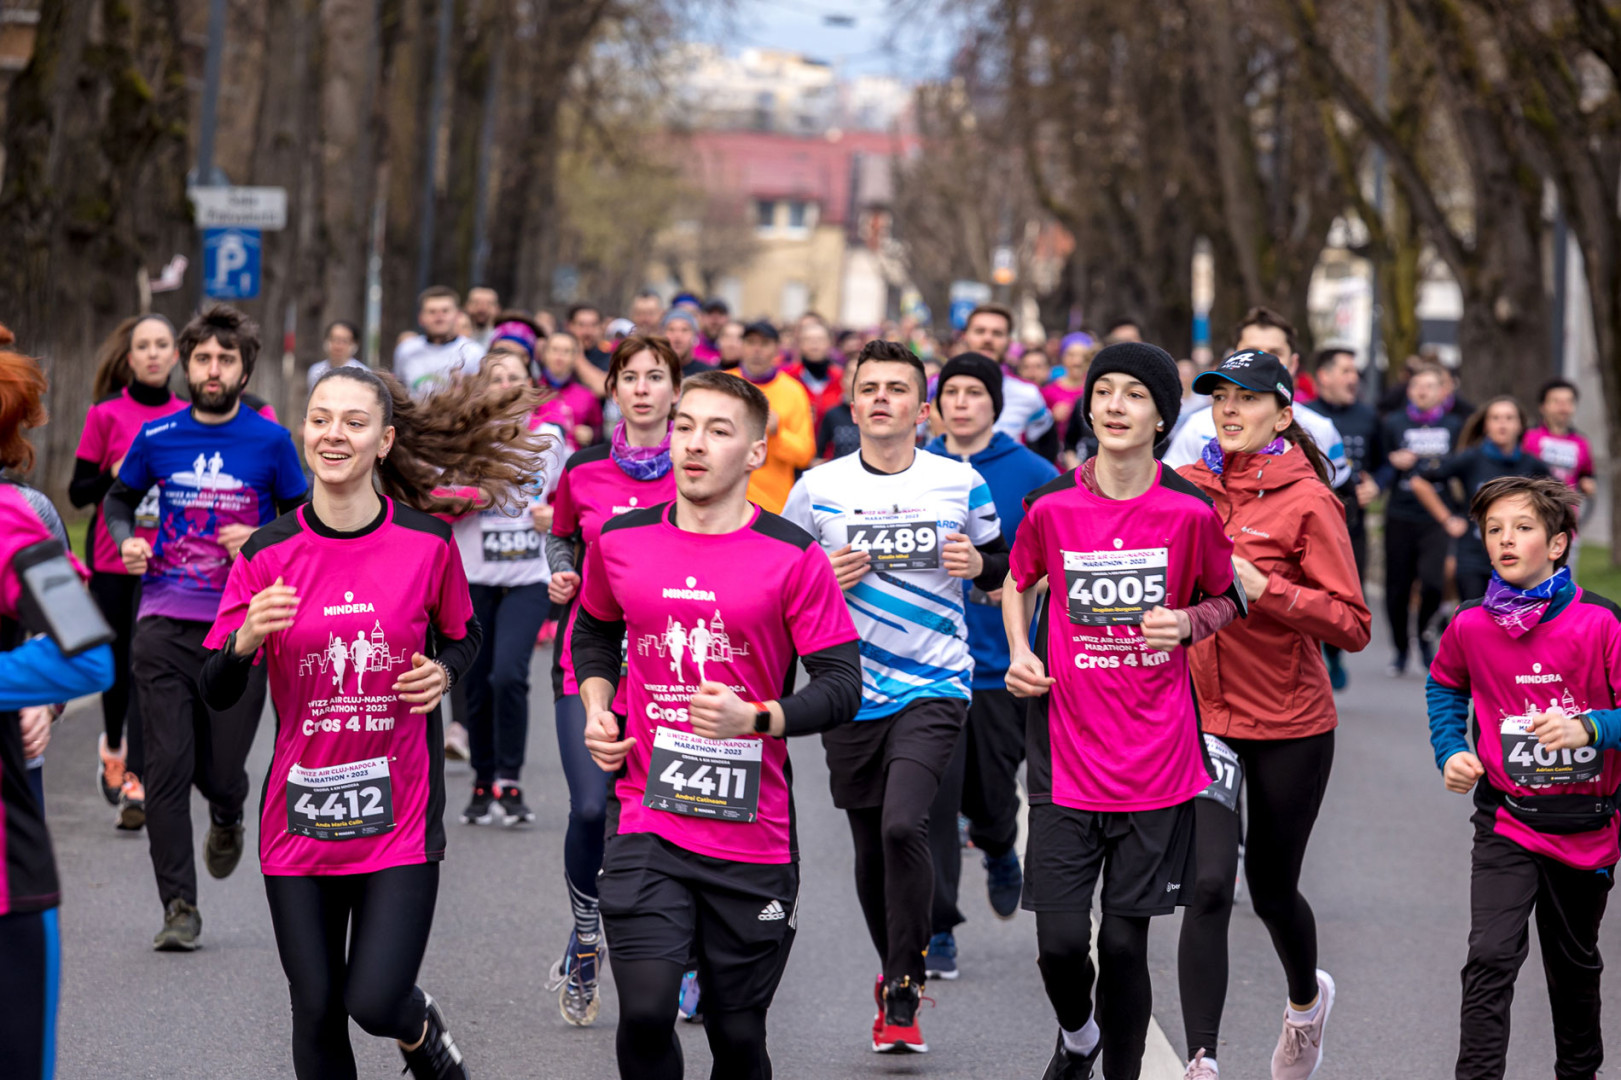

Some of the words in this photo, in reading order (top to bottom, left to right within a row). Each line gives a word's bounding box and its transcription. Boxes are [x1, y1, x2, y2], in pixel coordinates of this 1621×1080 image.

[851, 527, 936, 554] 4489
[662, 588, 716, 601] MINDERA
[1068, 574, 1165, 605] 4005
[324, 603, 374, 616] MINDERA
[1085, 643, 1132, 651] MARATHON
[1074, 653, 1120, 669] Cros
[1123, 653, 1138, 667] 4
[1141, 650, 1170, 666] km
[1515, 674, 1562, 684] MINDERA
[669, 684, 685, 692] AIR
[343, 695, 397, 704] CLUJ-NAPOCA
[312, 704, 357, 716] MARATHON
[646, 702, 689, 722] Cros
[302, 718, 341, 736] Cros
[345, 716, 360, 732] 4
[366, 715, 395, 732] km
[674, 741, 717, 754] MARATHON
[704, 738, 751, 749] CLUJ-NAPOCA
[1508, 742, 1597, 766] 4018
[331, 762, 377, 774] CLUJ-NAPOCA
[304, 775, 345, 783] MARATHON
[660, 760, 747, 799] 4411
[294, 786, 384, 820] 4412
[675, 793, 695, 802] Andrei
[758, 912, 785, 920] adidas
